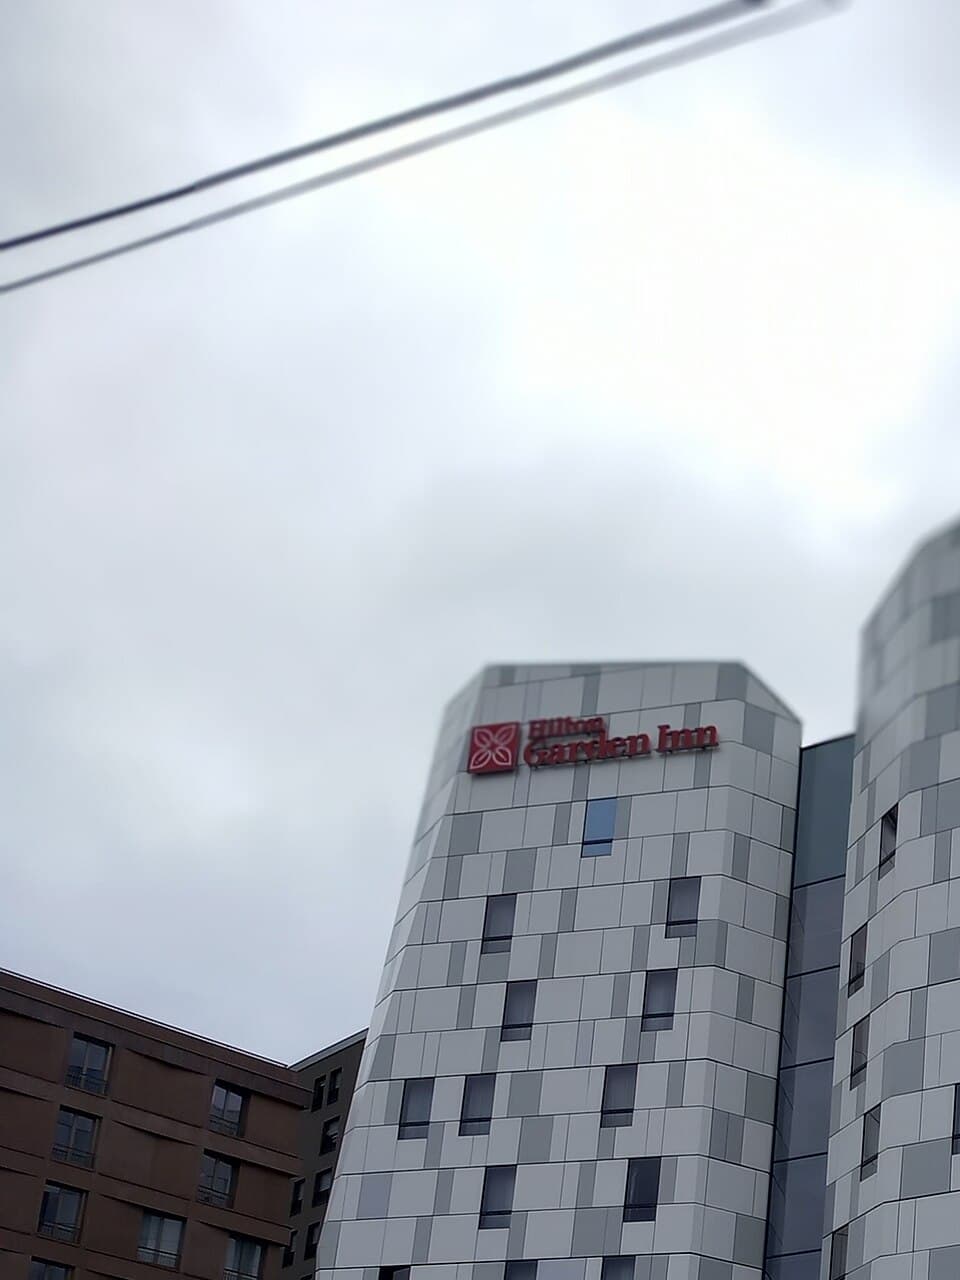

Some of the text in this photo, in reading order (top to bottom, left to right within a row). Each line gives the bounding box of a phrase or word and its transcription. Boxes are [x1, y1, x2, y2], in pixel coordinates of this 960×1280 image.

[528, 716, 606, 739] Hilton
[523, 723, 720, 767] Garden Inn
